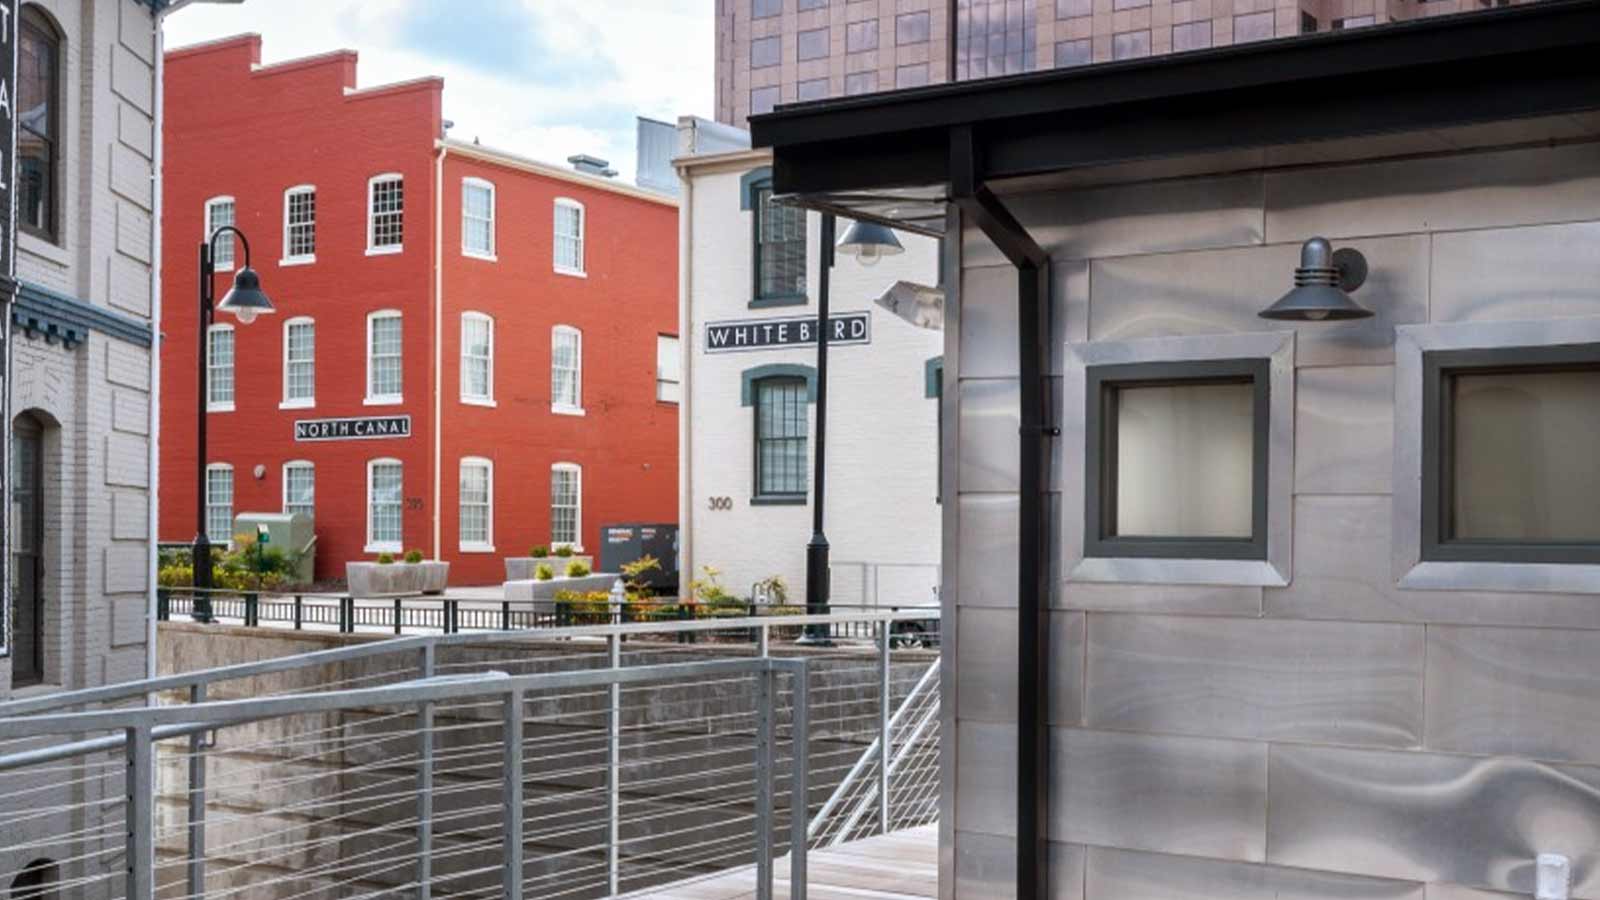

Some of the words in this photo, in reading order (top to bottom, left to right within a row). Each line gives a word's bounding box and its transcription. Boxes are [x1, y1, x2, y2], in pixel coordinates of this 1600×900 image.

[710, 324, 788, 346] WHITE
[799, 318, 865, 341] BRD
[297, 422, 349, 437] NORTH
[354, 420, 408, 435] CANAL
[707, 496, 733, 511] 300
